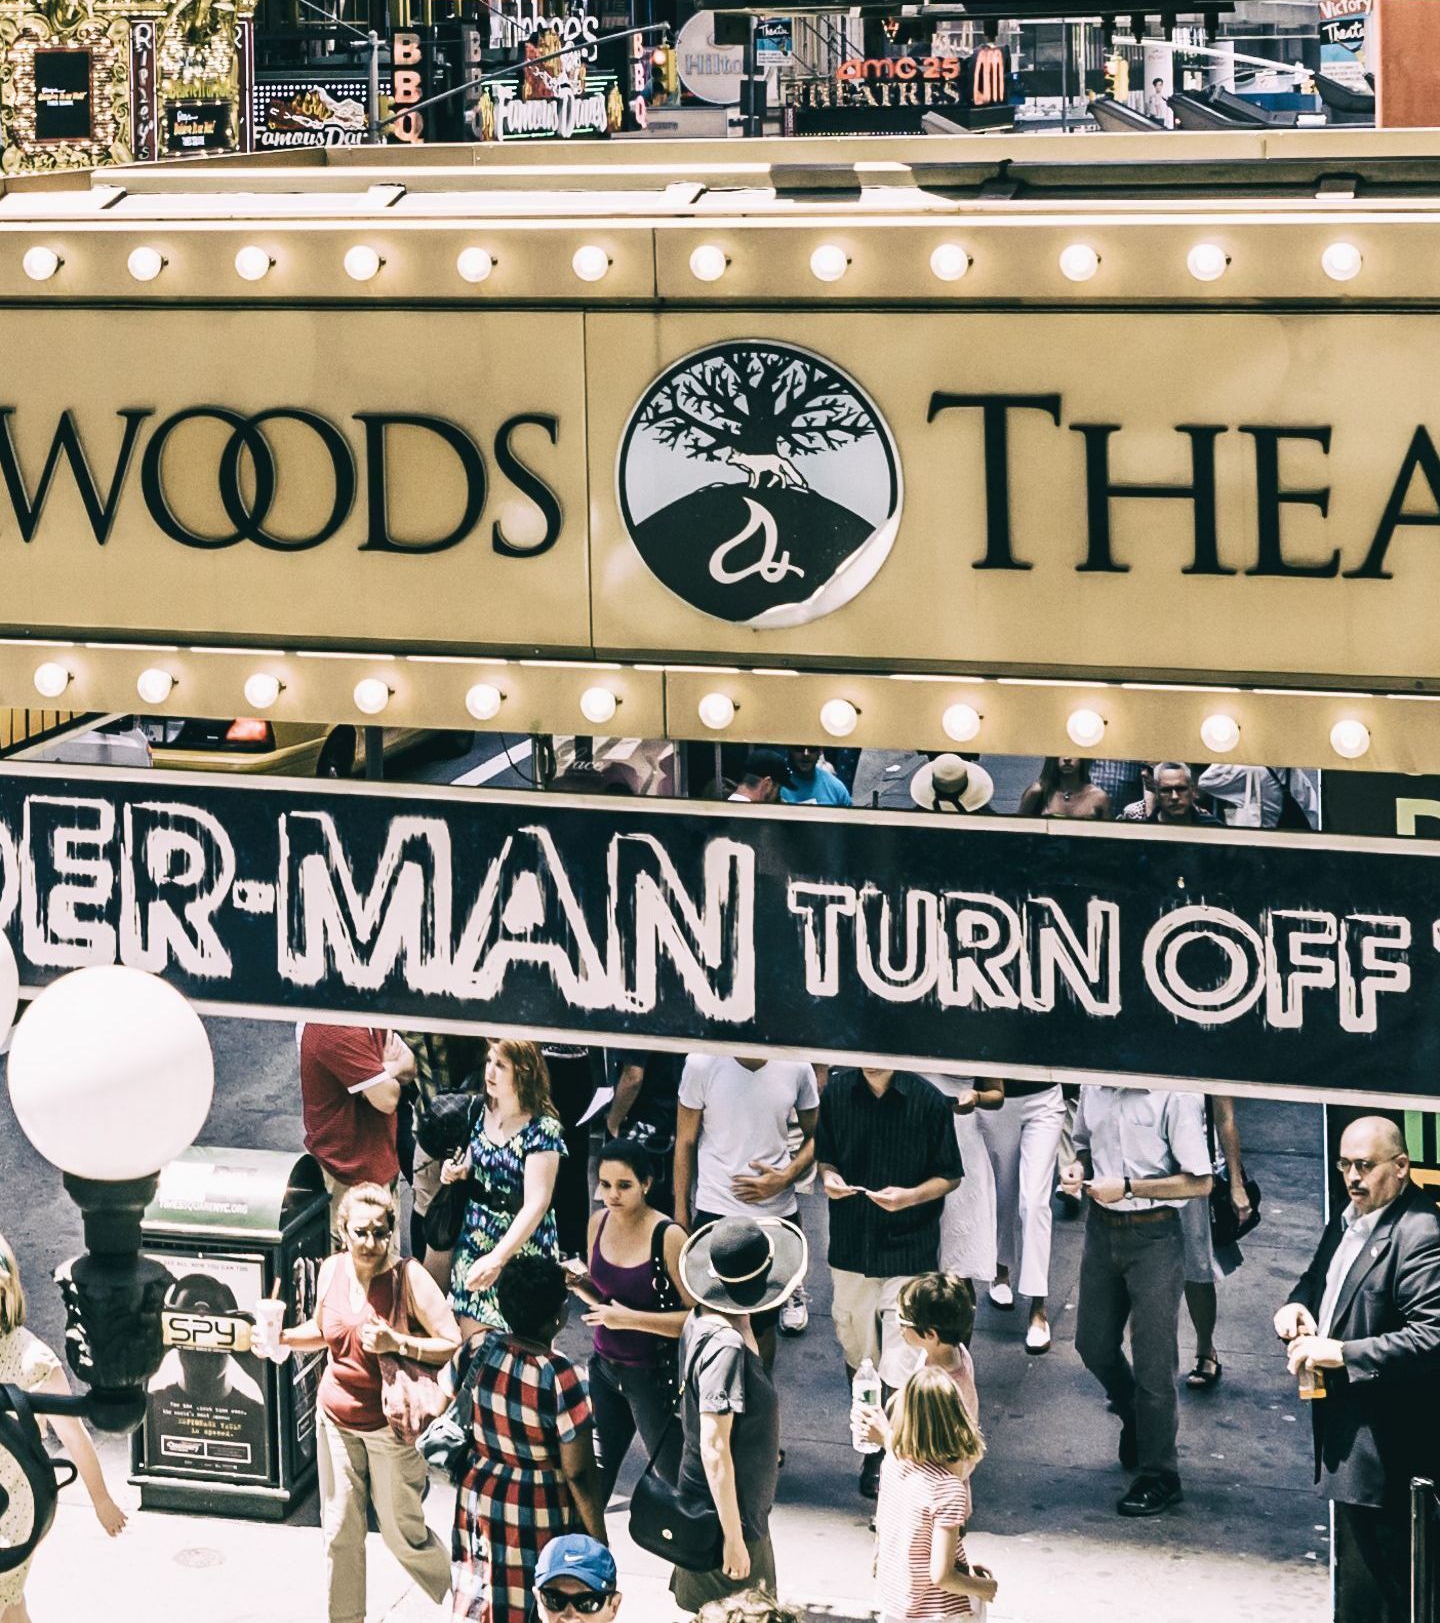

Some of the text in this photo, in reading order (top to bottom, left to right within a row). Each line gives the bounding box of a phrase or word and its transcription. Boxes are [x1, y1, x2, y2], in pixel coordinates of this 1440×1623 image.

[837, 57, 961, 80] amc 25
[253, 125, 325, 147] Famous
[787, 875, 1122, 1018] TURN
[1140, 902, 1413, 1035] OFF
[169, 1317, 237, 1347] SPY
